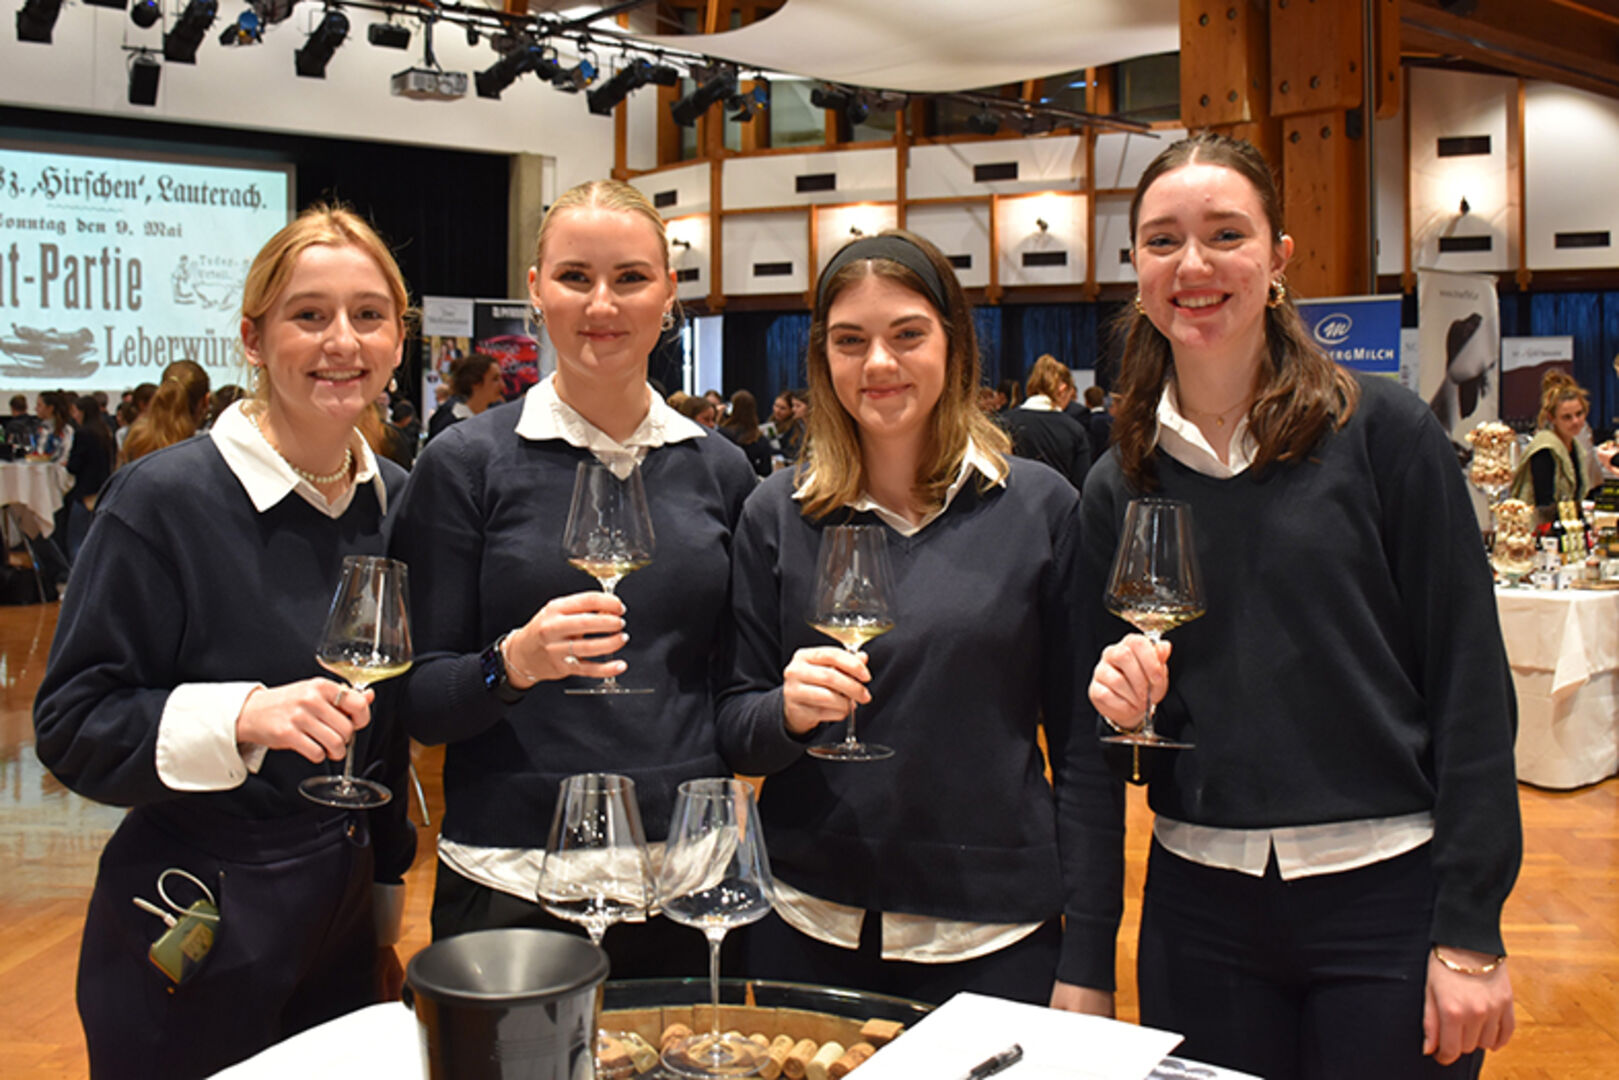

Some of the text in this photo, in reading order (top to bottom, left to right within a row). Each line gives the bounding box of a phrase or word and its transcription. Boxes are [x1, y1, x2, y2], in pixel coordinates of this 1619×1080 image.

[157, 174, 267, 212] Lauterach.
[76, 215, 107, 233] den
[144, 221, 183, 238] Mai
